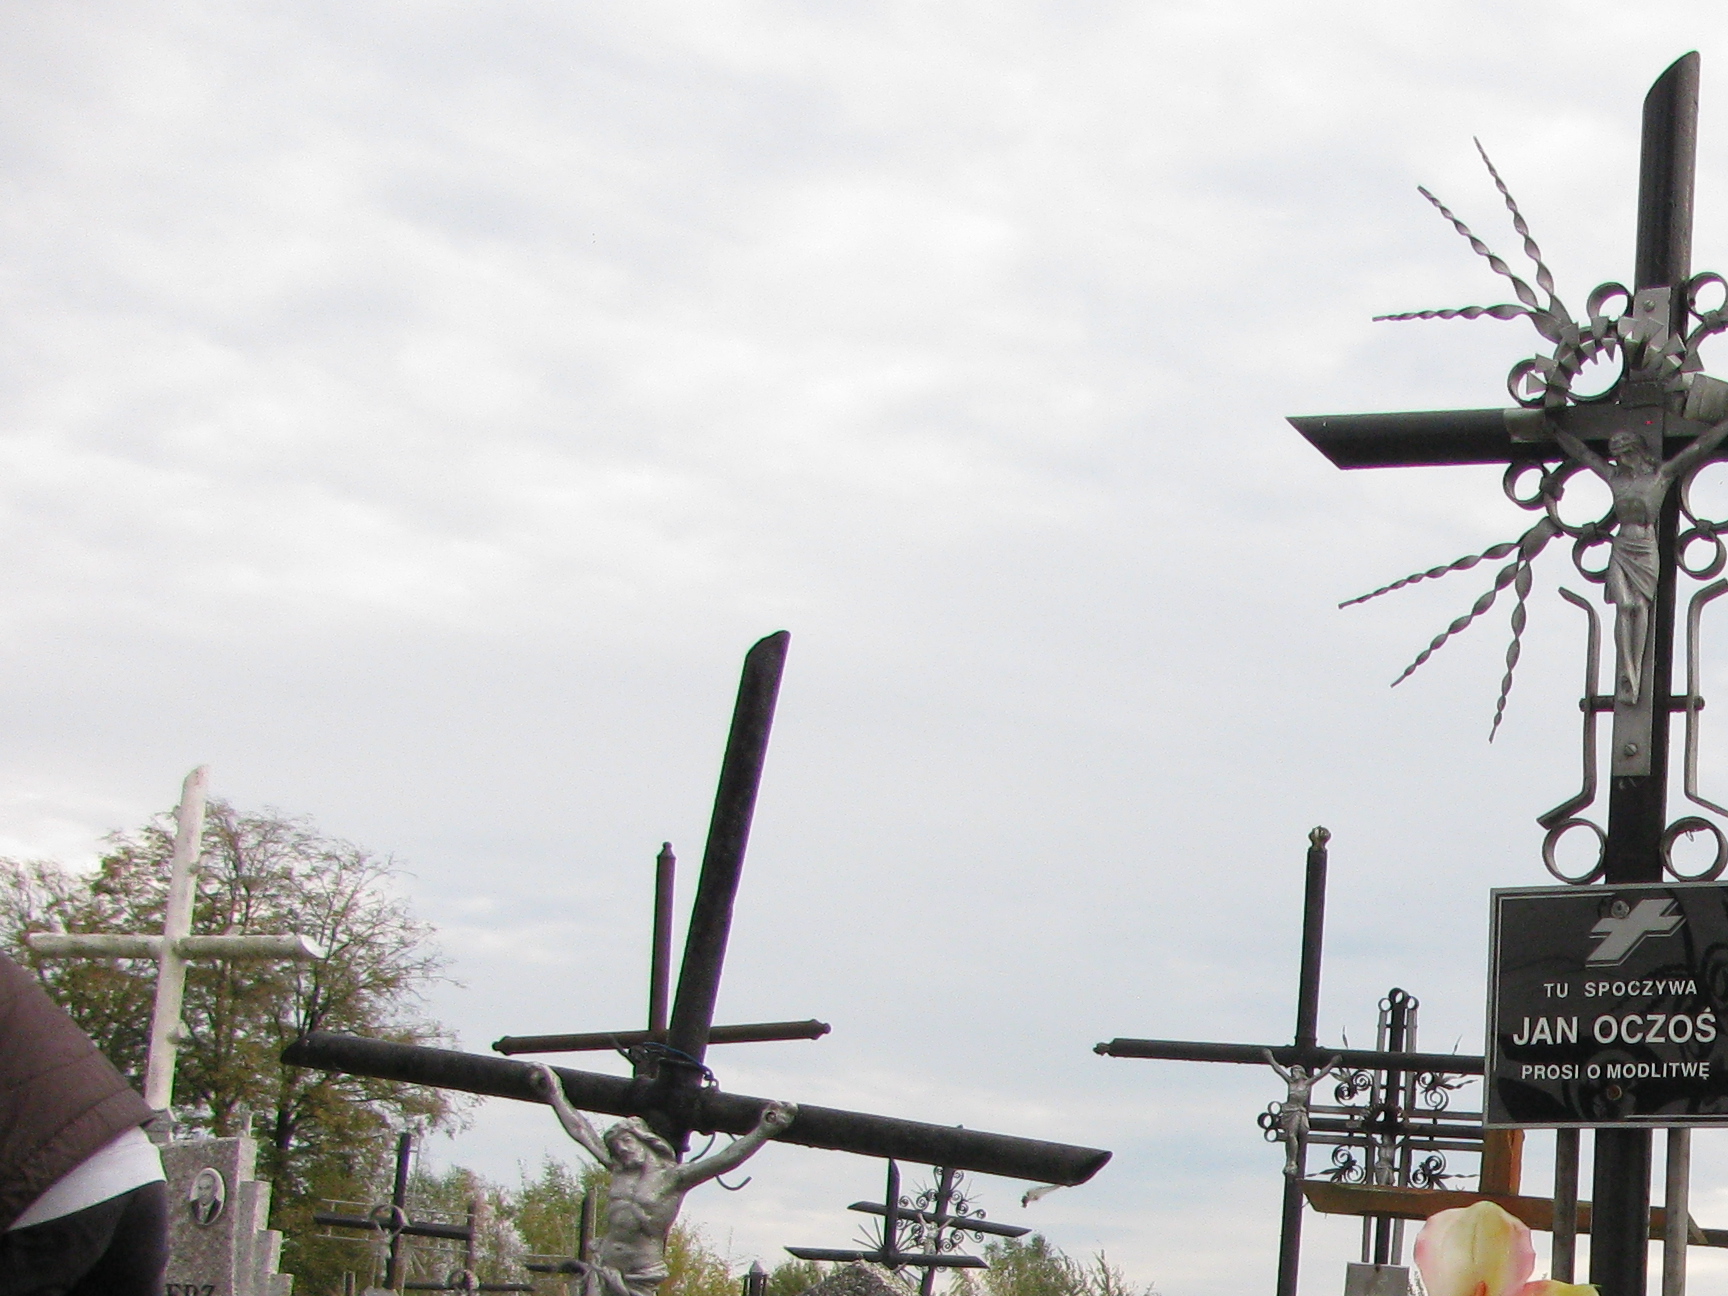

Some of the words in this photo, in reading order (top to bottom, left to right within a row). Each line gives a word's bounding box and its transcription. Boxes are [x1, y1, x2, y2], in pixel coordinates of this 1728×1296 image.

[1543, 982, 1570, 999] TU
[1583, 979, 1698, 998] SPOCZYWA
[1512, 1015, 1578, 1046] JAN
[1592, 1006, 1718, 1046] OCZOŚ
[1521, 1063, 1579, 1081] PROSI
[1586, 1063, 1601, 1080] O
[1606, 1061, 1711, 1081] MODLITWĘ
